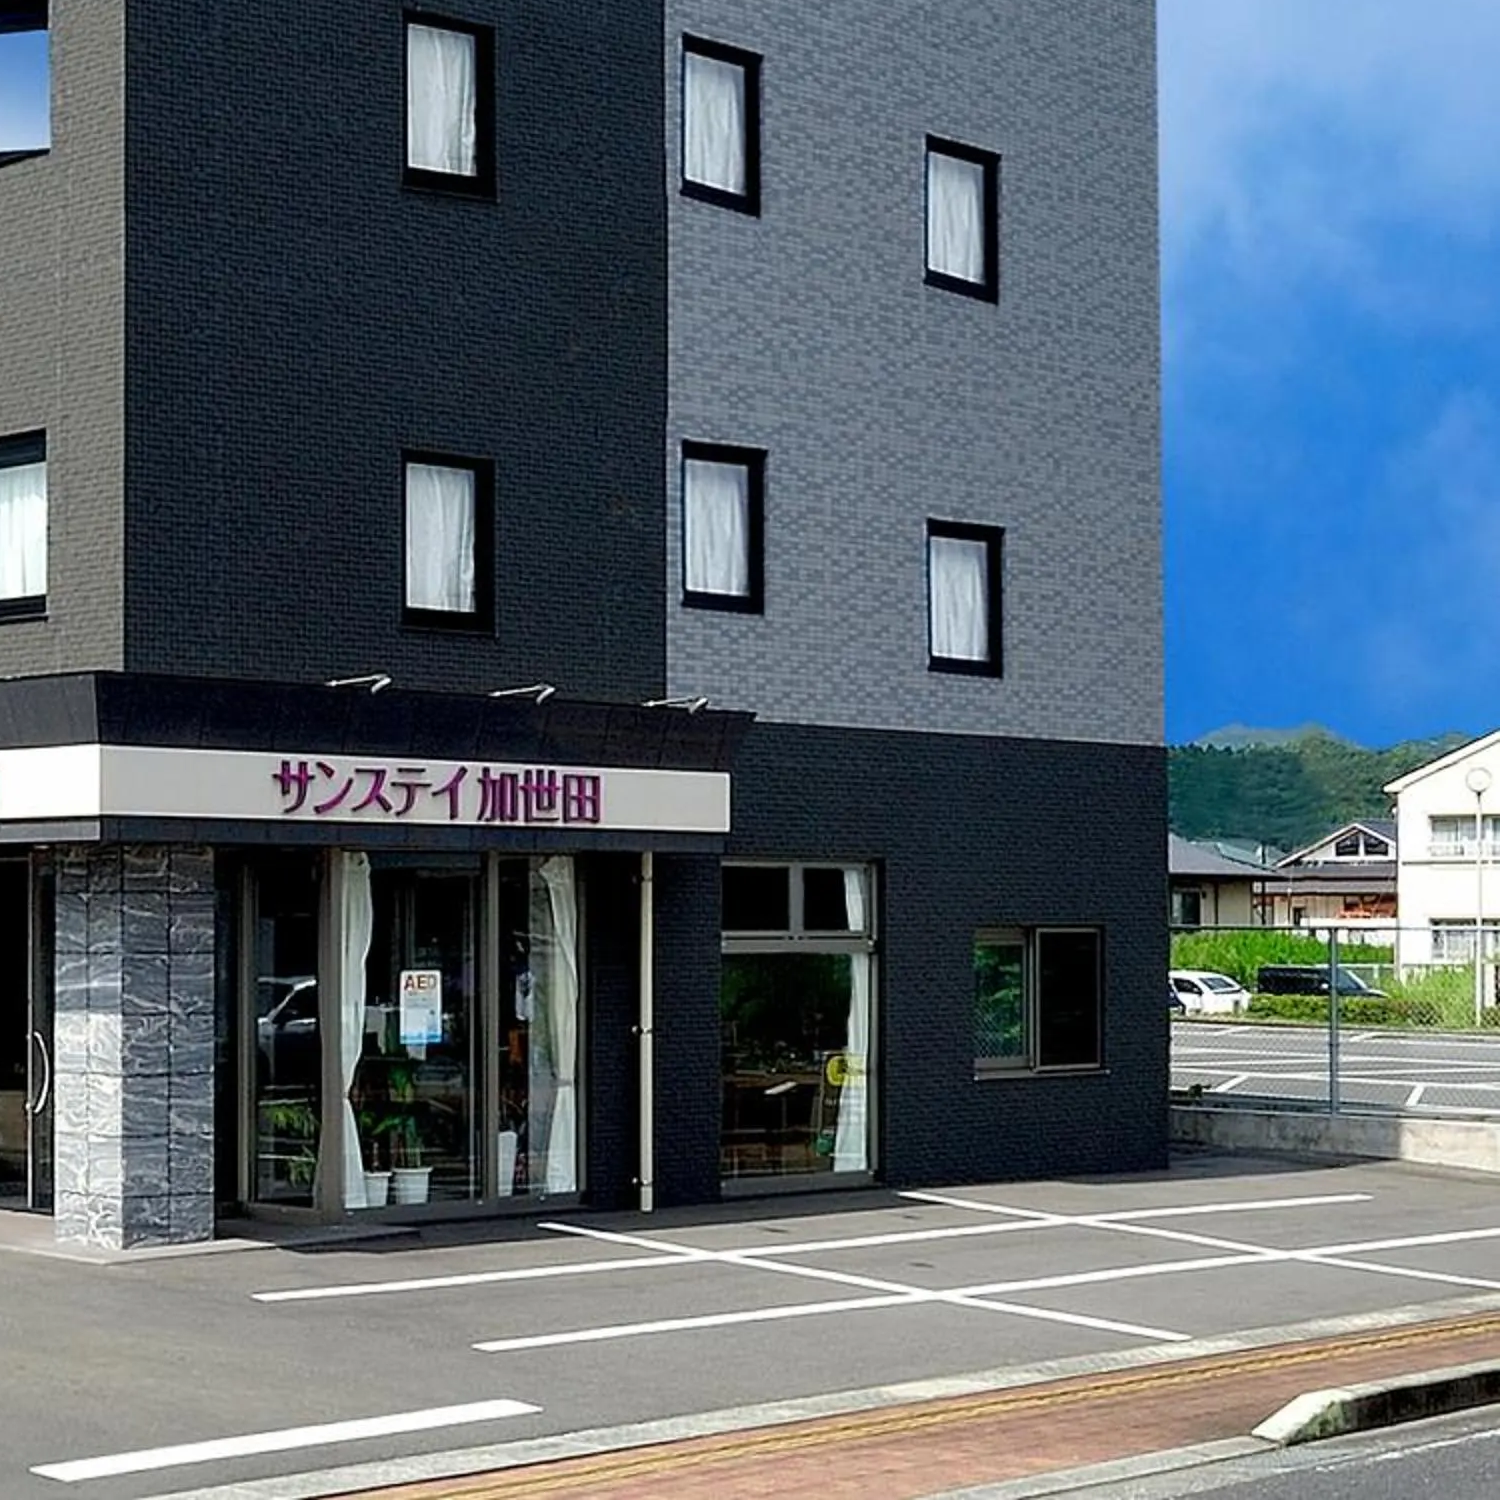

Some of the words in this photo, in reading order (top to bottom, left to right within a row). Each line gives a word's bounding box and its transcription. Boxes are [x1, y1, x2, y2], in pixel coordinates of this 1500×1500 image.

[271, 760, 601, 824] サンステイ加世田
[403, 974, 438, 991] AED
